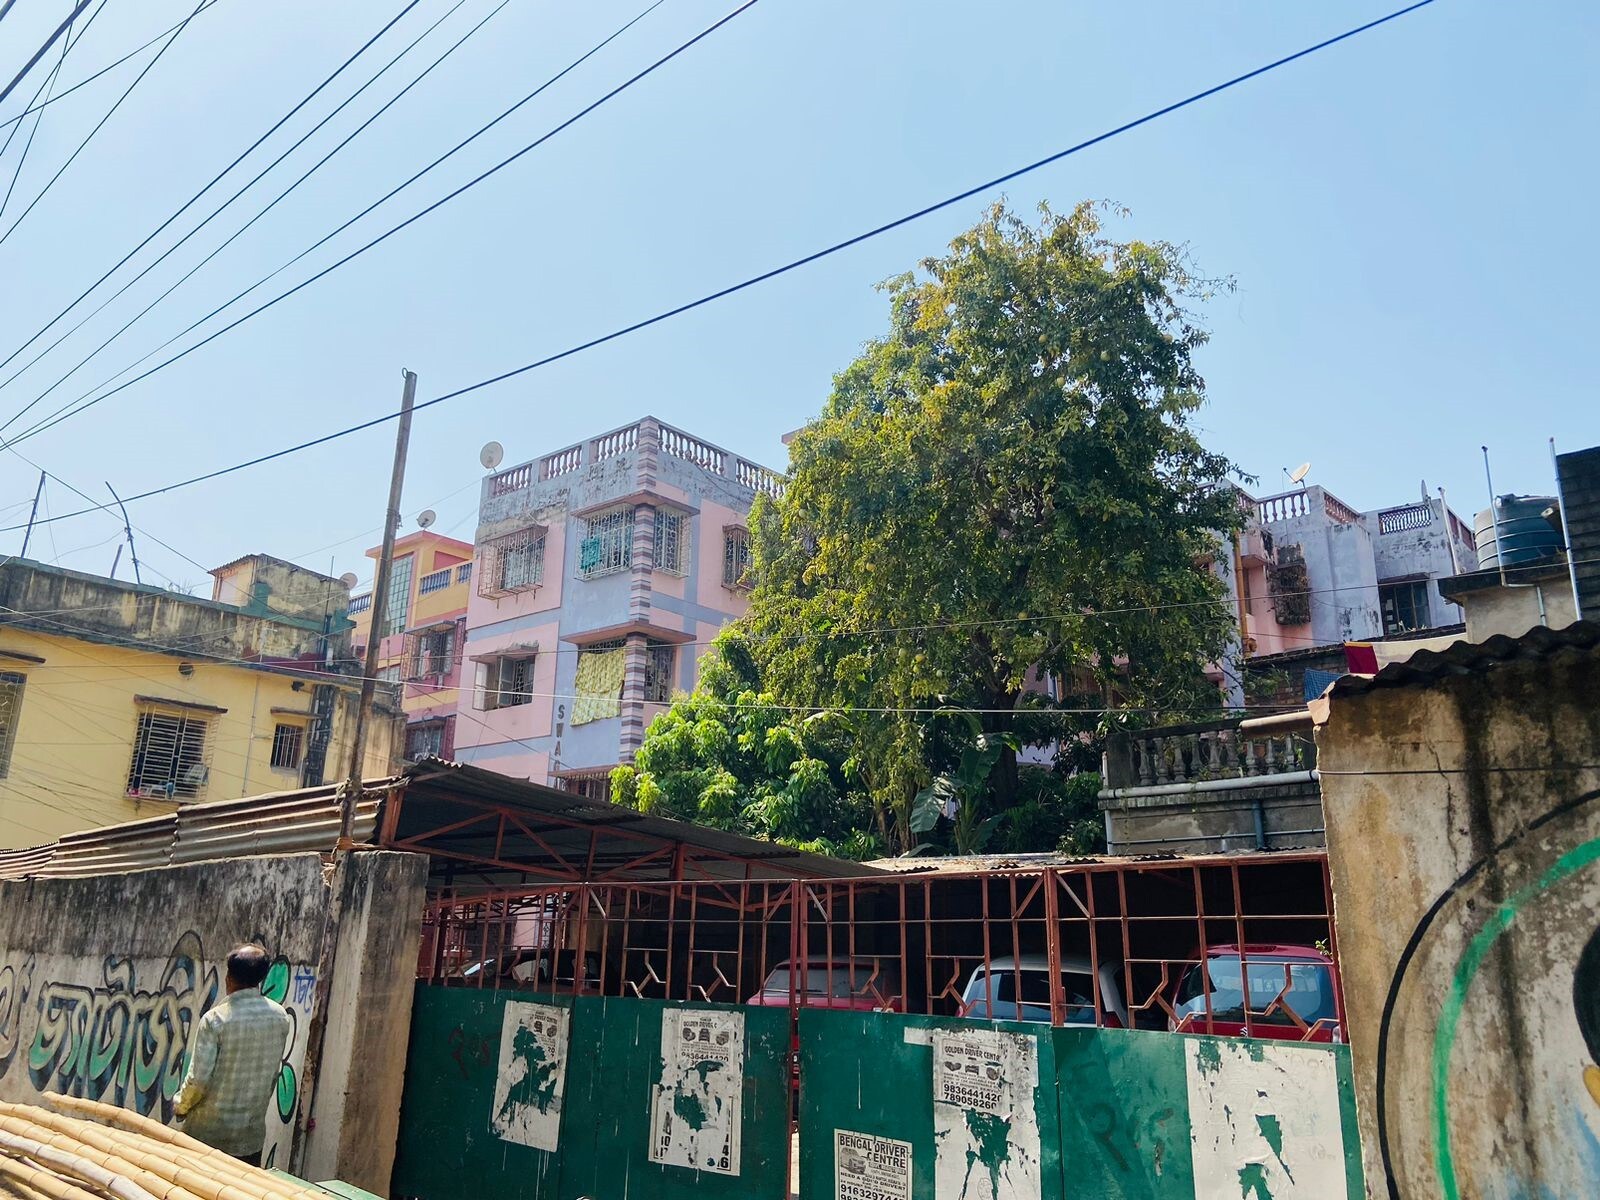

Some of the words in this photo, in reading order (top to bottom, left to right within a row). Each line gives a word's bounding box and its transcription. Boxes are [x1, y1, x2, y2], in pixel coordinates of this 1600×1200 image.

[944, 1045, 963, 1054] GOLDEN
[965, 1048, 983, 1058] DRIVER
[984, 1051, 1001, 1062] CENTR
[840, 1135, 872, 1152] BENGAL
[874, 1142, 906, 1158] DRIVER
[867, 1152, 906, 1169] CENTRE
